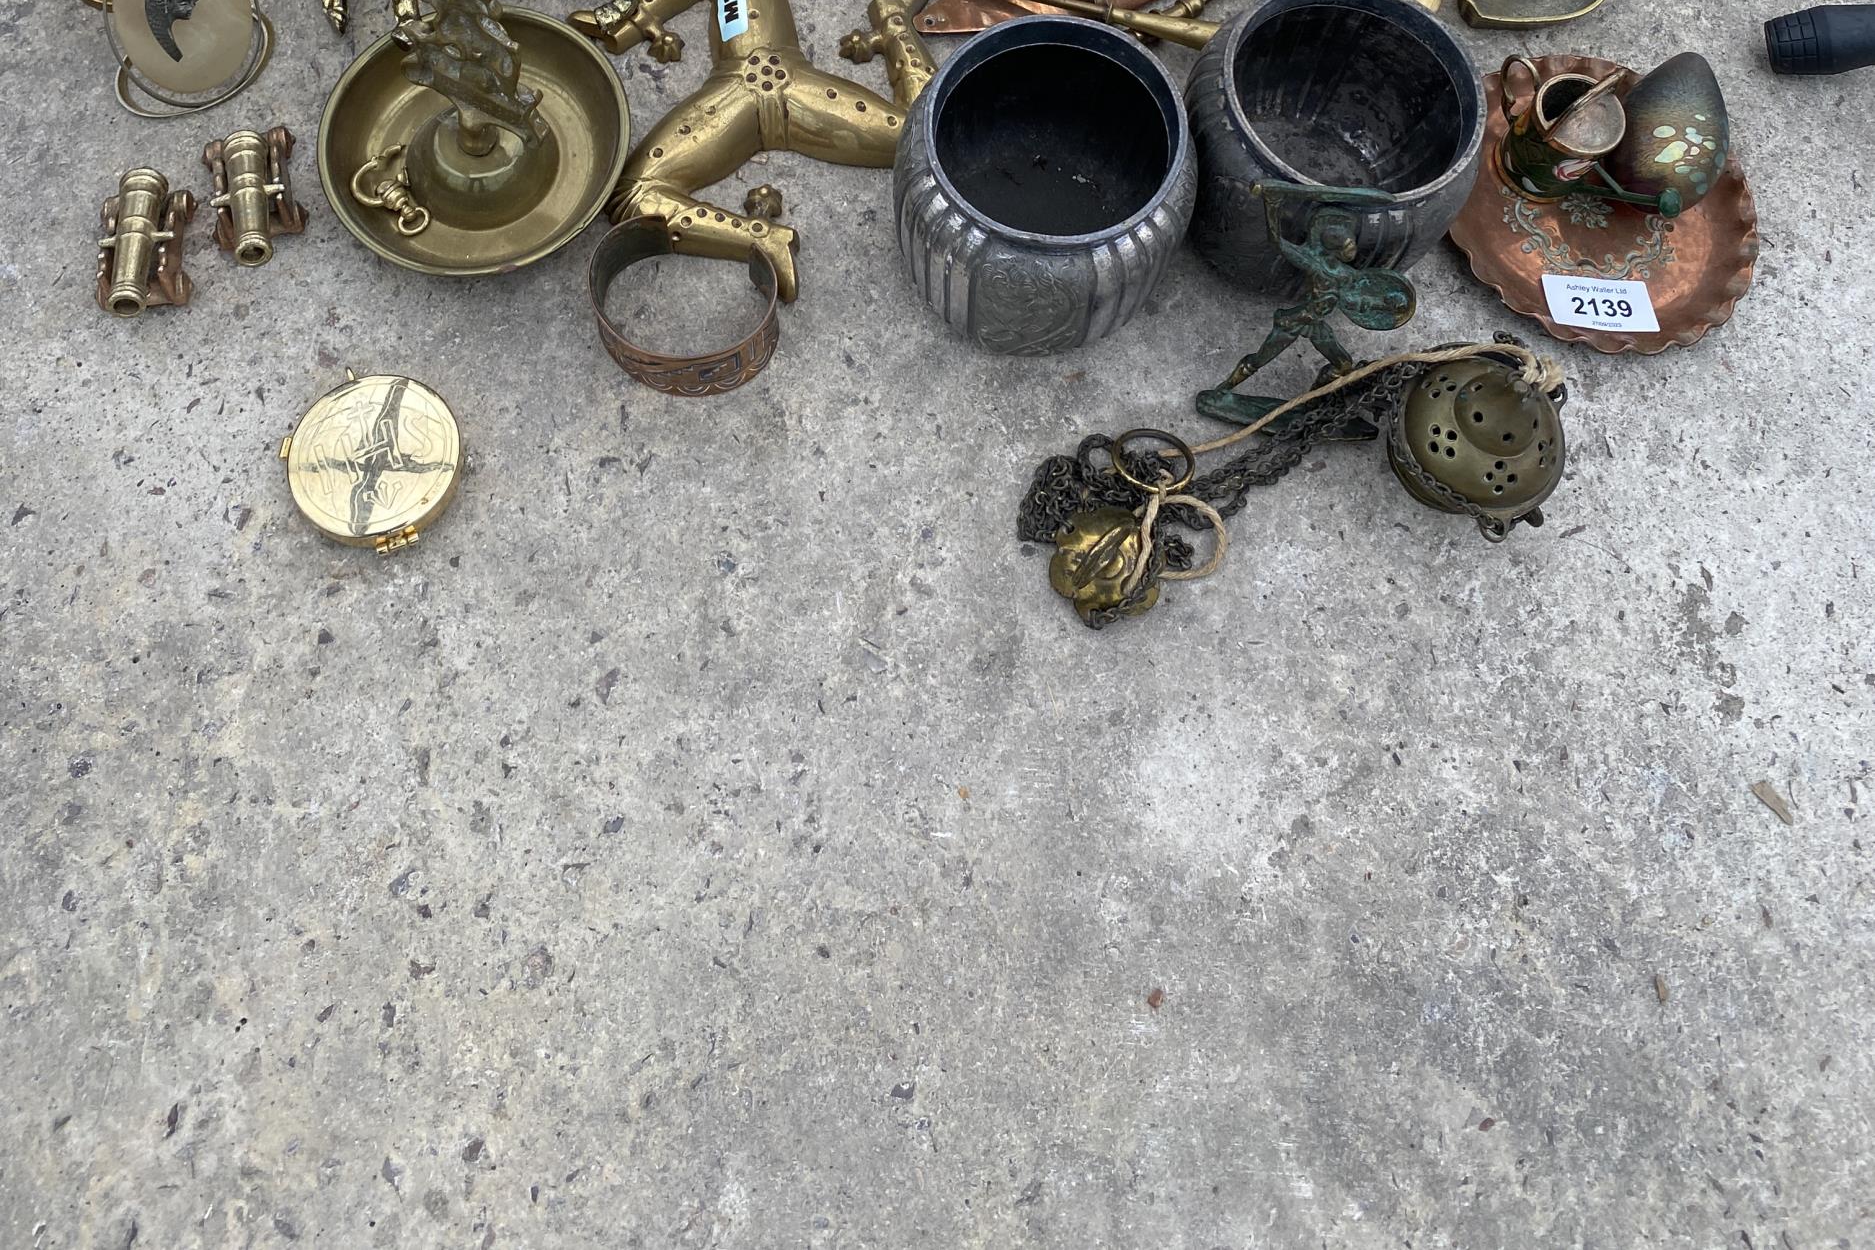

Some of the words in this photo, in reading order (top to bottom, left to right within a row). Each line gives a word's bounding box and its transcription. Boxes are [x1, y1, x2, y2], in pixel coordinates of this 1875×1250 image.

[1566, 283, 1590, 293] Ashley
[1591, 285, 1614, 294] Waller
[1615, 287, 1628, 295] Ltd
[1571, 296, 1633, 318] 2139
